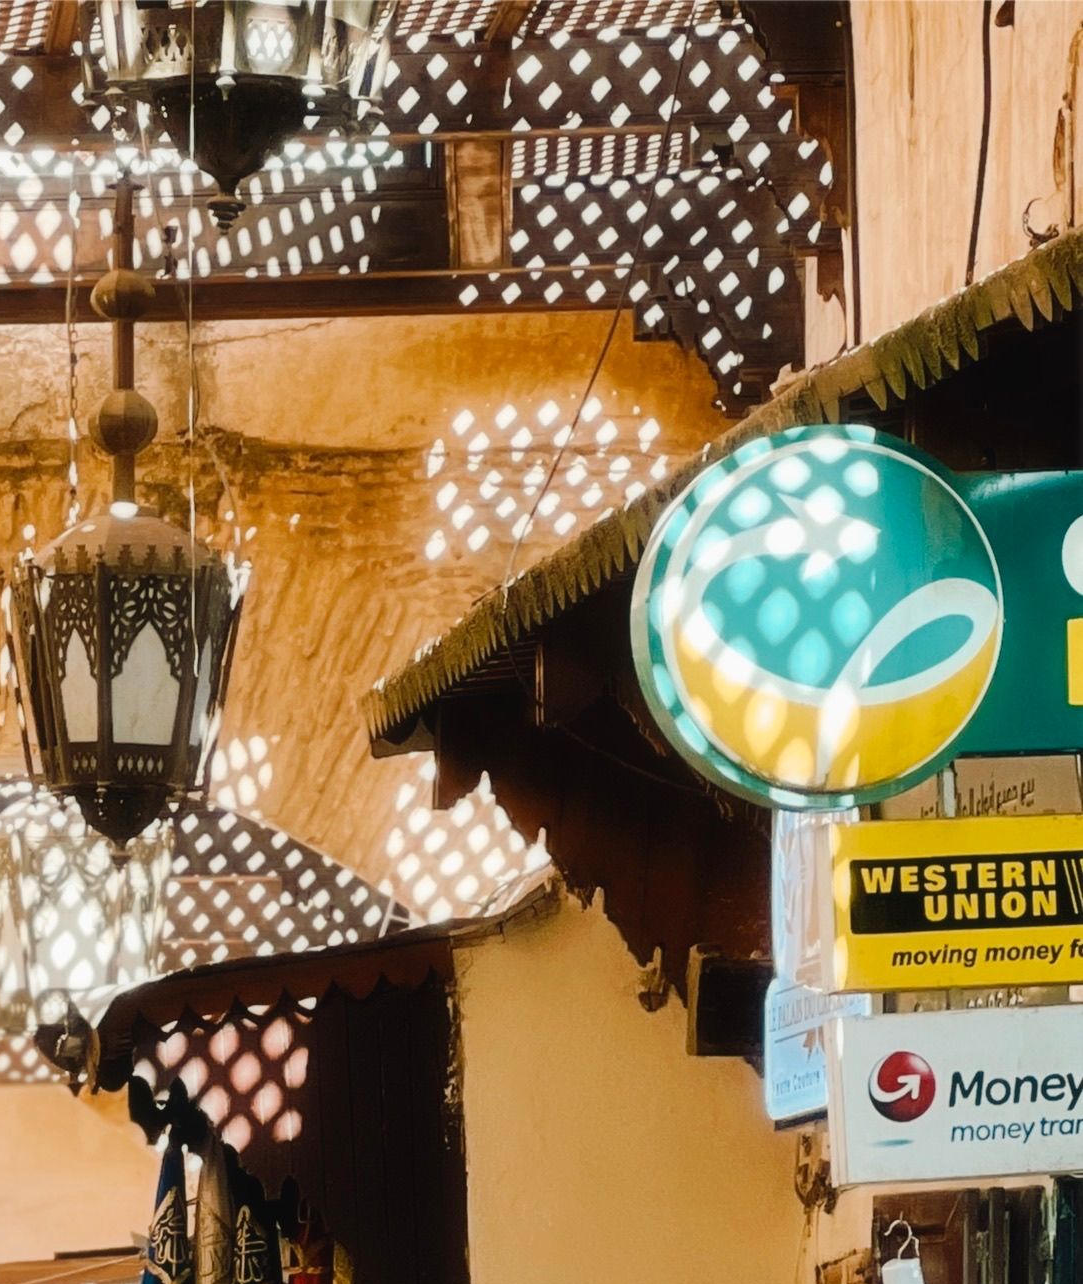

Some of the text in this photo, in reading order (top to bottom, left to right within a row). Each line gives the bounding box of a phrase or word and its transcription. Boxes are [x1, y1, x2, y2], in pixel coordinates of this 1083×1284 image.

[861, 860, 1056, 893] WESTERN
[924, 890, 1057, 921] UNION
[892, 944, 977, 967] moving
[985, 943, 1063, 964] money
[949, 1070, 1083, 1111] Money
[951, 1121, 1035, 1143] money
